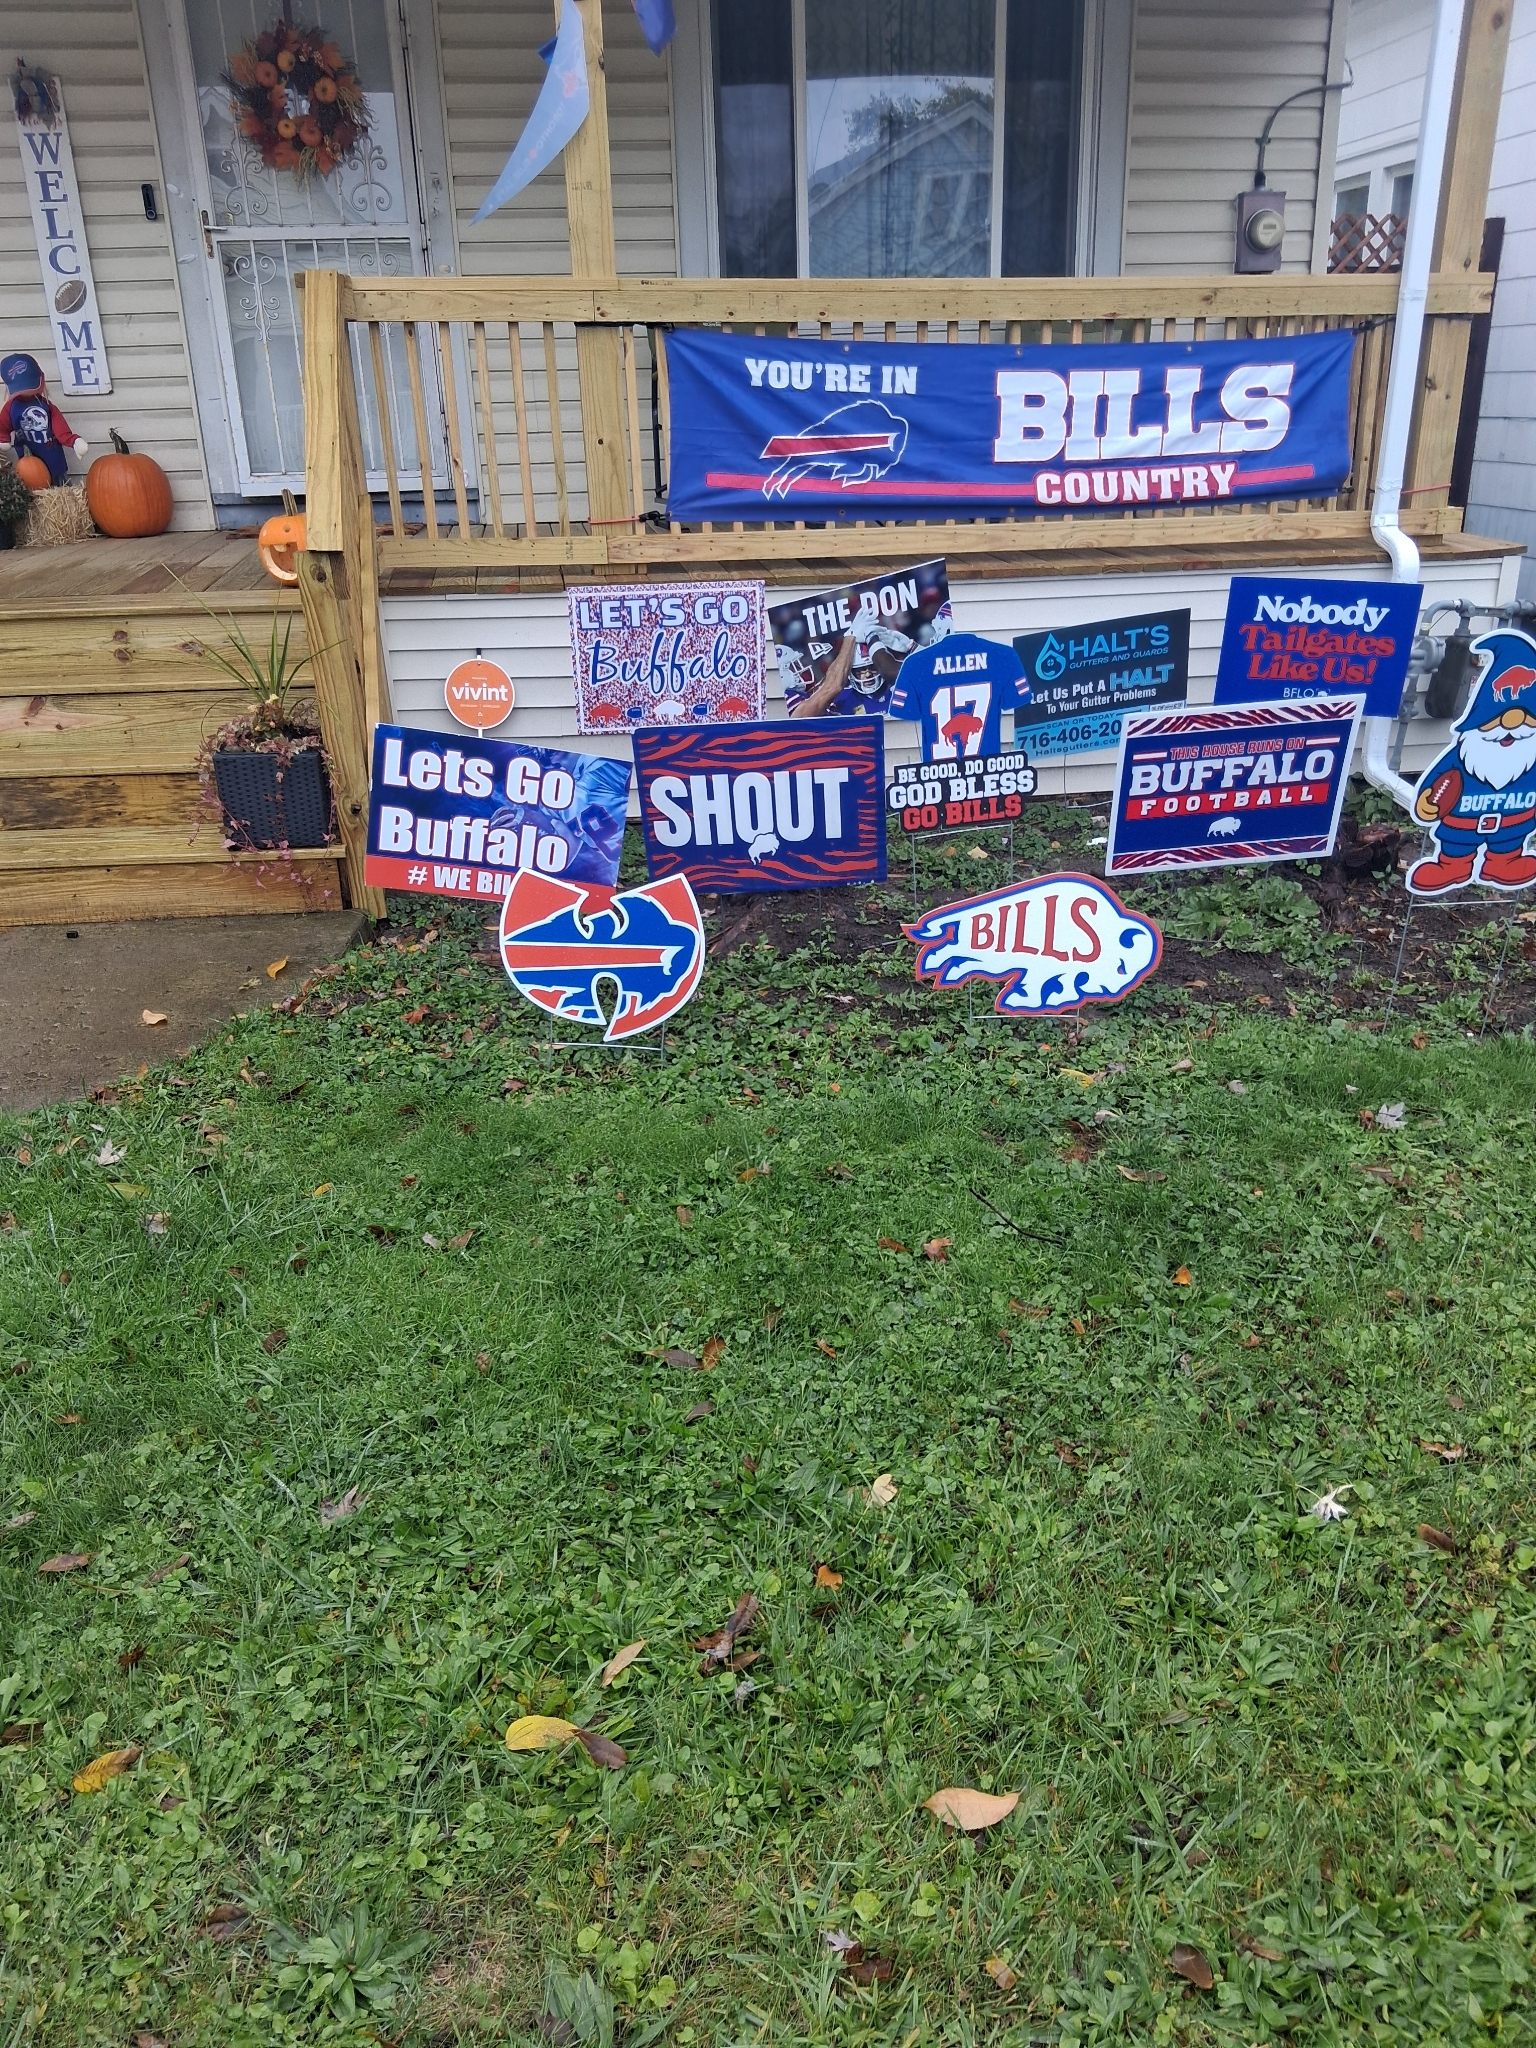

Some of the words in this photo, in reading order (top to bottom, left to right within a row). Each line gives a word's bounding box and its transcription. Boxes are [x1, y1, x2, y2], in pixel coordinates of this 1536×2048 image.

[745, 358, 871, 393] YOU'RE
[881, 365, 918, 394] IN
[993, 363, 1295, 463] BILLS
[1035, 462, 1237, 504] COUNTRY
[577, 596, 686, 630] LET'S
[694, 594, 749, 626] GO
[802, 597, 851, 638] THE
[859, 579, 919, 618] DON
[1253, 595, 1390, 632] Nobody
[1069, 624, 1170, 660] HALT'S
[1070, 657, 1109, 670] GUTTERS
[1111, 653, 1130, 663] AND
[1133, 647, 1169, 659] GUARDS
[1239, 624, 1396, 658] Tailgates
[586, 630, 748, 694] Buffalo
[933, 652, 988, 675] ALLEN
[1247, 653, 1319, 680] Like
[1322, 656, 1378, 684] Us!
[451, 682, 509, 702] vivint
[1030, 689, 1049, 704] Let
[1053, 687, 1068, 700] Us
[1072, 681, 1093, 697] Put
[1097, 679, 1106, 692] A
[1109, 663, 1175, 692] HALT
[1046, 703, 1056, 715] To
[1059, 700, 1079, 712] Your
[1081, 695, 1111, 708] Gutter
[1114, 687, 1157, 703] Problems
[1283, 687, 1315, 698] BFLO
[930, 682, 992, 760] 17
[1017, 719, 1122, 750] 716-406-20
[1046, 719, 1070, 730] SCAN
[1088, 712, 1116, 722] TODAY
[1170, 747, 1199, 760] THIS
[1202, 742, 1245, 757] HOUSE
[1247, 739, 1283, 754] RUNS
[1286, 737, 1305, 750] ON
[383, 738, 494, 798] Lets
[505, 757, 575, 810] Go
[897, 767, 917, 784] BE
[920, 762, 962, 780] GOOD,
[965, 760, 984, 774] DO
[987, 754, 1025, 773] GOOD
[1129, 749, 1335, 796] BUFFALO
[649, 767, 849, 847] SHOUT
[889, 781, 942, 809] GOD
[949, 769, 1034, 802] BLESS
[1140, 786, 1313, 816] FOOTBALL
[1459, 791, 1536, 812] BUFFALO
[903, 805, 938, 830] GO
[944, 794, 1022, 826] BILLS
[378, 805, 569, 873] Buffalo
[433, 865, 471, 891] WE
[971, 894, 1102, 963] BILLS
